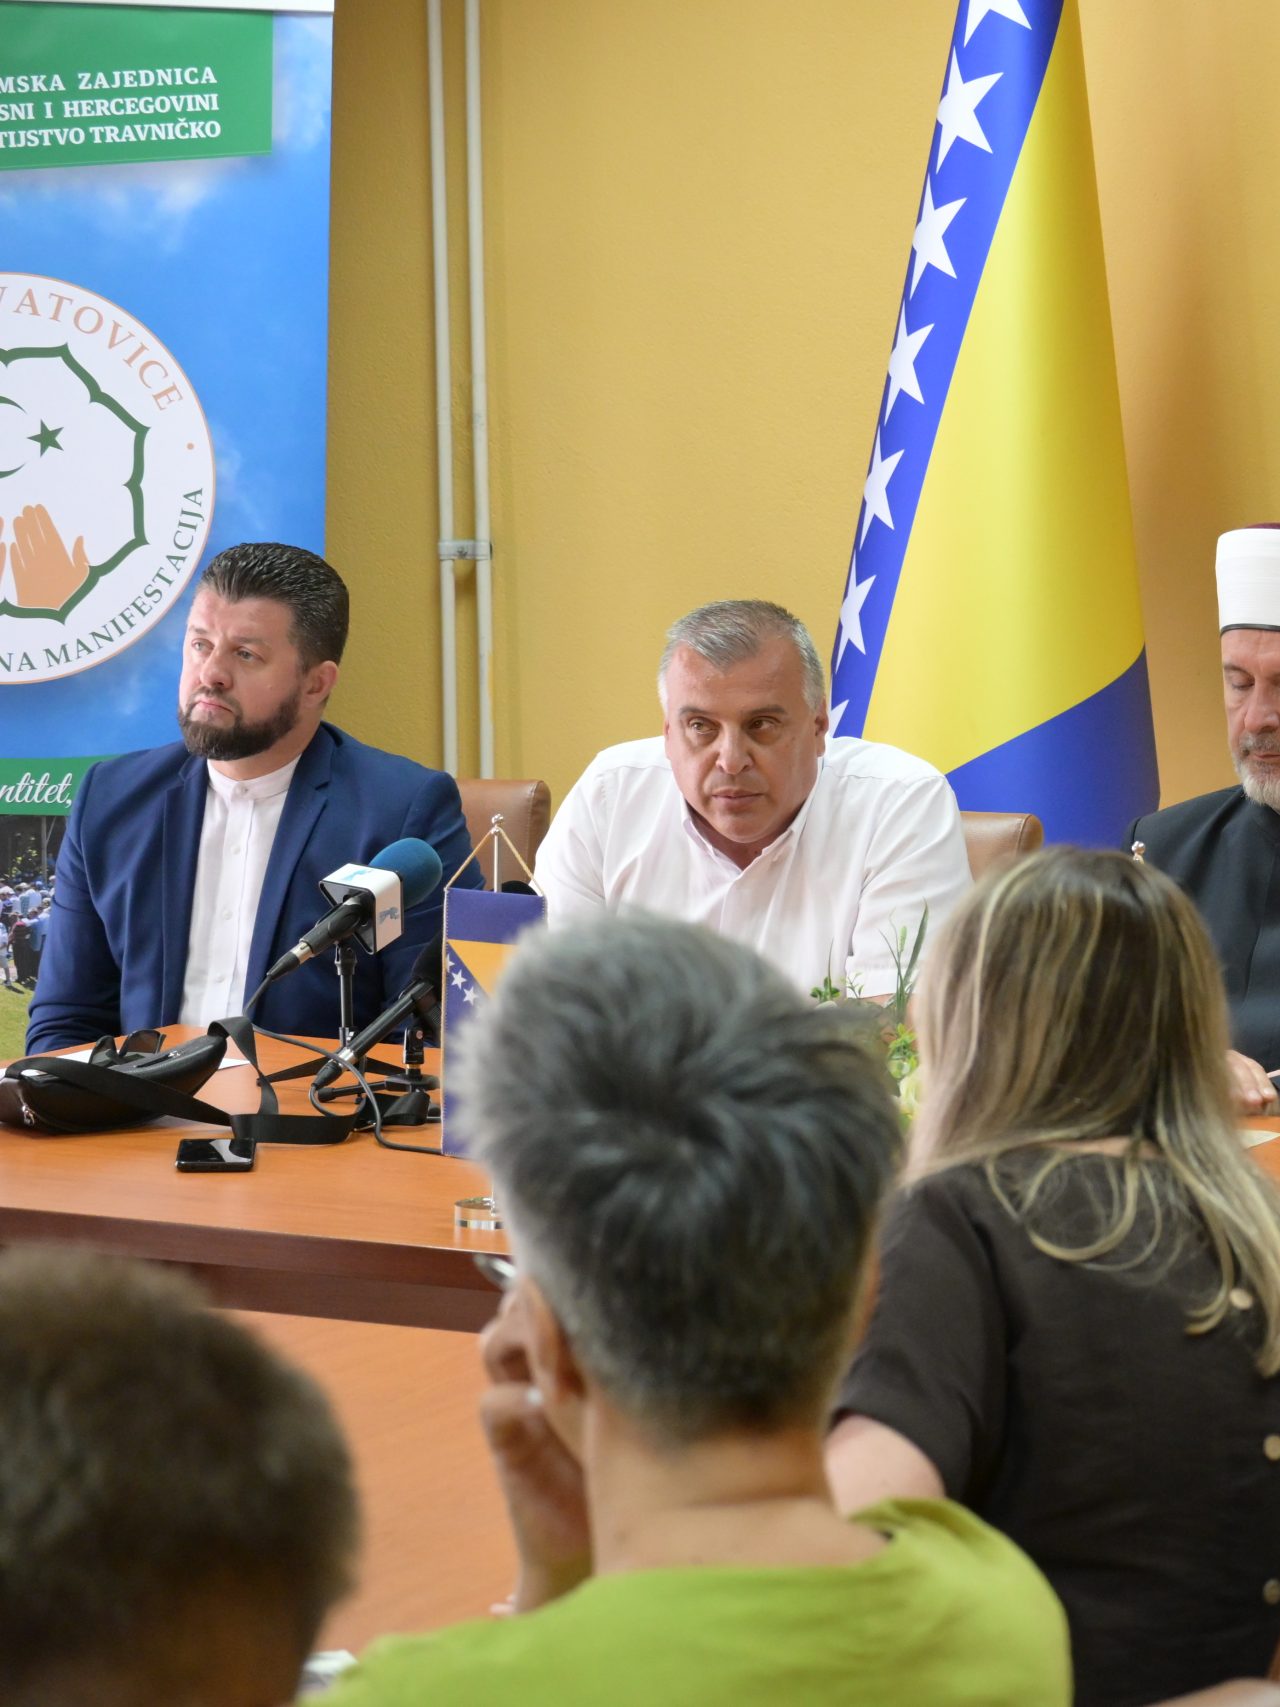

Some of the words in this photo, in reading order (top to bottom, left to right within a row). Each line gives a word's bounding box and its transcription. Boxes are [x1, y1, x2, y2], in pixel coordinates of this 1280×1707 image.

[78, 66, 217, 90] ZAJEDNICA
[44, 102, 54, 119] I
[63, 93, 219, 118] HERCEGOVINI
[89, 117, 221, 144] TRAVNIČKO
[45, 487, 204, 670] MANIFESTACIJA
